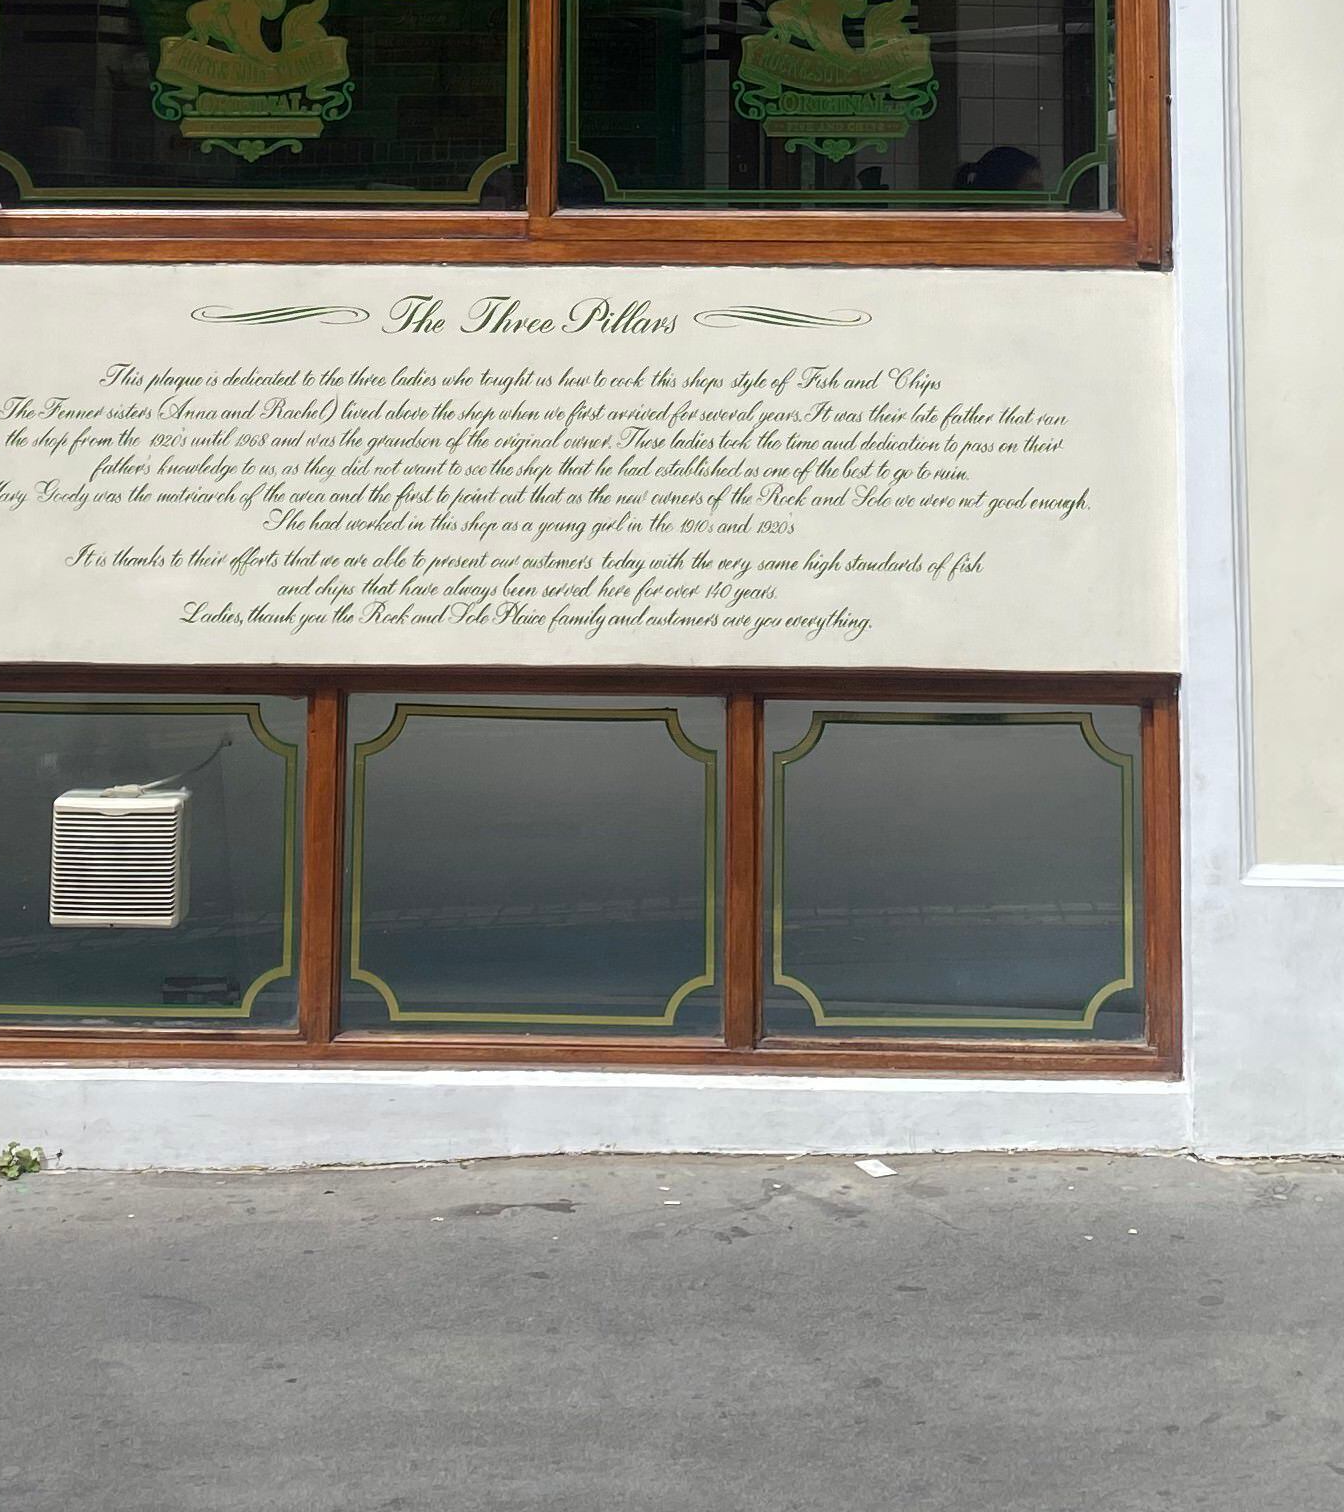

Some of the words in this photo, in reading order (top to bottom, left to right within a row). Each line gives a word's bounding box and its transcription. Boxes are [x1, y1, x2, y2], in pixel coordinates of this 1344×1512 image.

[382, 295, 446, 334] The
[460, 295, 555, 334] Three
[563, 296, 677, 334] Pillars
[99, 362, 144, 386] This
[143, 367, 203, 393] plaque
[205, 370, 219, 386] is
[222, 367, 297, 387] dedicated
[302, 369, 316, 387] to
[318, 366, 344, 387] the
[348, 366, 386, 387] three
[391, 366, 437, 387] ladies
[442, 367, 473, 387] who
[536, 375, 553, 387] us
[558, 367, 590, 387] how
[594, 369, 607, 387] to
[610, 366, 645, 387] cook
[651, 367, 676, 387] this
[682, 367, 724, 394] shops
[730, 370, 767, 397] style
[770, 368, 797, 397] of
[799, 366, 844, 389] Fish
[843, 370, 880, 389] and
[889, 367, 941, 398] Chips
[39, 397, 105, 421] Fenner
[106, 404, 152, 420] sisters
[156, 395, 217, 421] (Anna
[220, 398, 255, 420] and
[259, 392, 339, 424] Rachel)
[341, 400, 380, 421] lived
[385, 400, 428, 421] above
[432, 400, 458, 421] the
[461, 400, 497, 428] shop
[499, 400, 540, 421] when
[543, 408, 565, 421] we
[564, 400, 607, 428] first
[607, 400, 674, 422] arrived
[668, 399, 699, 428] for
[699, 400, 758, 422] several
[757, 409, 802, 430] years.
[803, 399, 832, 423] It
[834, 409, 863, 423] was
[868, 402, 906, 424] their
[909, 402, 938, 424] late
[939, 403, 994, 431] father
[998, 404, 1034, 425] that
[1036, 414, 1069, 426] ran
[262, 508, 307, 531] She
[308, 509, 343, 531] had
[344, 509, 403, 531] worked
[407, 517, 424, 532] in
[430, 510, 457, 532] this
[460, 511, 499, 541] shop
[502, 521, 519, 532] as
[521, 521, 533, 532] a
[537, 521, 588, 543] young
[591, 510, 632, 539] girl
[627, 516, 643, 532] in
[649, 510, 674, 533] the
[717, 513, 754, 533] and
[64, 543, 96, 568] It
[96, 551, 108, 567] is
[111, 544, 165, 567] thanks
[169, 549, 184, 567] to
[187, 545, 227, 567] their
[229, 545, 279, 576] efforts
[283, 546, 318, 568] that
[320, 556, 341, 568] we
[344, 556, 369, 568] are
[372, 545, 407, 568] able
[411, 549, 425, 568] to
[423, 551, 488, 575] present
[491, 557, 519, 569] our
[522, 552, 592, 569] customers
[601, 549, 646, 577] today
[649, 548, 690, 570] with
[691, 549, 713, 570] the
[718, 559, 752, 580] very
[757, 559, 799, 571] same
[802, 549, 846, 579] high
[845, 551, 923, 573] standards
[927, 551, 954, 581] of
[947, 551, 986, 581] fish
[179, 601, 244, 625] Ladies,
[247, 602, 296, 624] thank
[293, 612, 328, 635] you
[332, 603, 355, 624] the
[358, 600, 410, 625] Rock
[411, 604, 450, 624] and
[449, 601, 491, 625] Sole
[492, 601, 546, 625] Plaice
[547, 603, 606, 639] family
[608, 605, 651, 626] and
[646, 608, 718, 627] customers
[723, 616, 752, 628] owe
[744, 618, 783, 641] you
[784, 606, 873, 642] everything.
